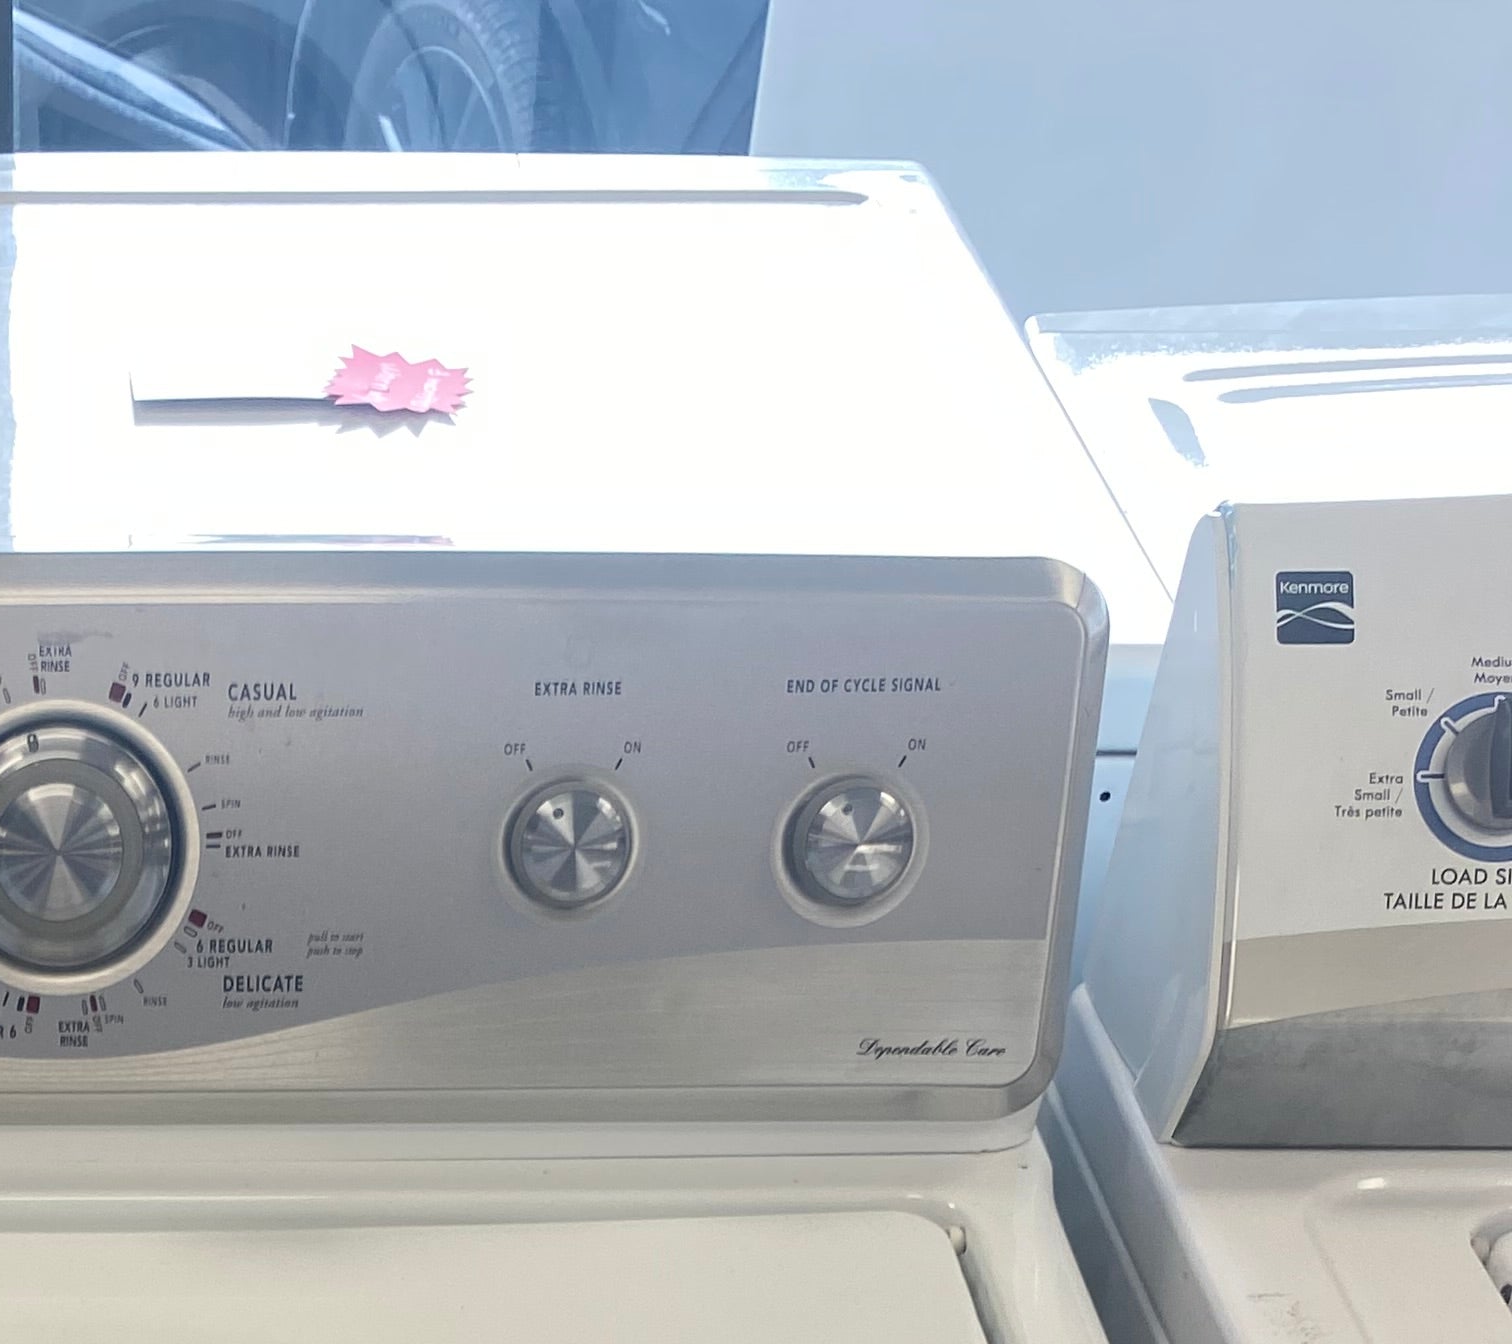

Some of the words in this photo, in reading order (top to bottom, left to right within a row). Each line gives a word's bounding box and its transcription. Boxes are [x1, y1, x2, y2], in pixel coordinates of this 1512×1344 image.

[1280, 582, 1349, 594] Kenmore
[39, 645, 72, 657] EXTRA
[40, 660, 70, 672] RINSE
[1471, 656, 1512, 668] Mediu
[132, 674, 139, 687] 9
[145, 673, 210, 688] REGULAR
[1474, 672, 1512, 686] Moye
[534, 682, 577, 696] EXTRA
[583, 681, 622, 695] RINSE
[787, 679, 815, 693] END
[820, 679, 838, 693] OF
[844, 678, 886, 693] CYCLE
[891, 678, 941, 692] SIGNAL
[228, 683, 297, 701] CASUAL
[1386, 689, 1422, 701] Small
[153, 696, 160, 707] 6
[164, 696, 198, 708] LIGHT
[228, 706, 253, 722] high
[258, 706, 281, 718] and
[285, 705, 305, 718] low
[310, 707, 364, 721] agitation
[1392, 705, 1428, 717] Petite
[504, 743, 526, 755] OFF
[623, 741, 641, 753] ON
[787, 741, 809, 752] OFF
[907, 739, 926, 750] ON
[1369, 773, 1404, 785] Extra
[1354, 789, 1390, 801] Small
[1335, 805, 1360, 818] Très
[1365, 806, 1402, 821] petite
[225, 830, 242, 839] OFF
[225, 846, 262, 858] EXTRA
[266, 846, 300, 857] RINSE
[1432, 868, 1487, 885] LOAD
[1384, 893, 1444, 910] TAILLE
[1451, 893, 1477, 910] DE
[1484, 893, 1507, 910] LA
[196, 940, 204, 953] 6
[209, 939, 273, 953] REGULAR
[187, 957, 194, 968] 3
[198, 957, 229, 969] LIGHT
[223, 976, 304, 993] DELICATE
[223, 997, 243, 1009] low
[246, 998, 299, 1012] agitation
[9, 1025, 17, 1039] 6
[58, 1021, 90, 1033] EXTRA
[59, 1036, 88, 1047] RINSE
[855, 1038, 959, 1060] Dependable
[965, 1038, 1006, 1056] Care
